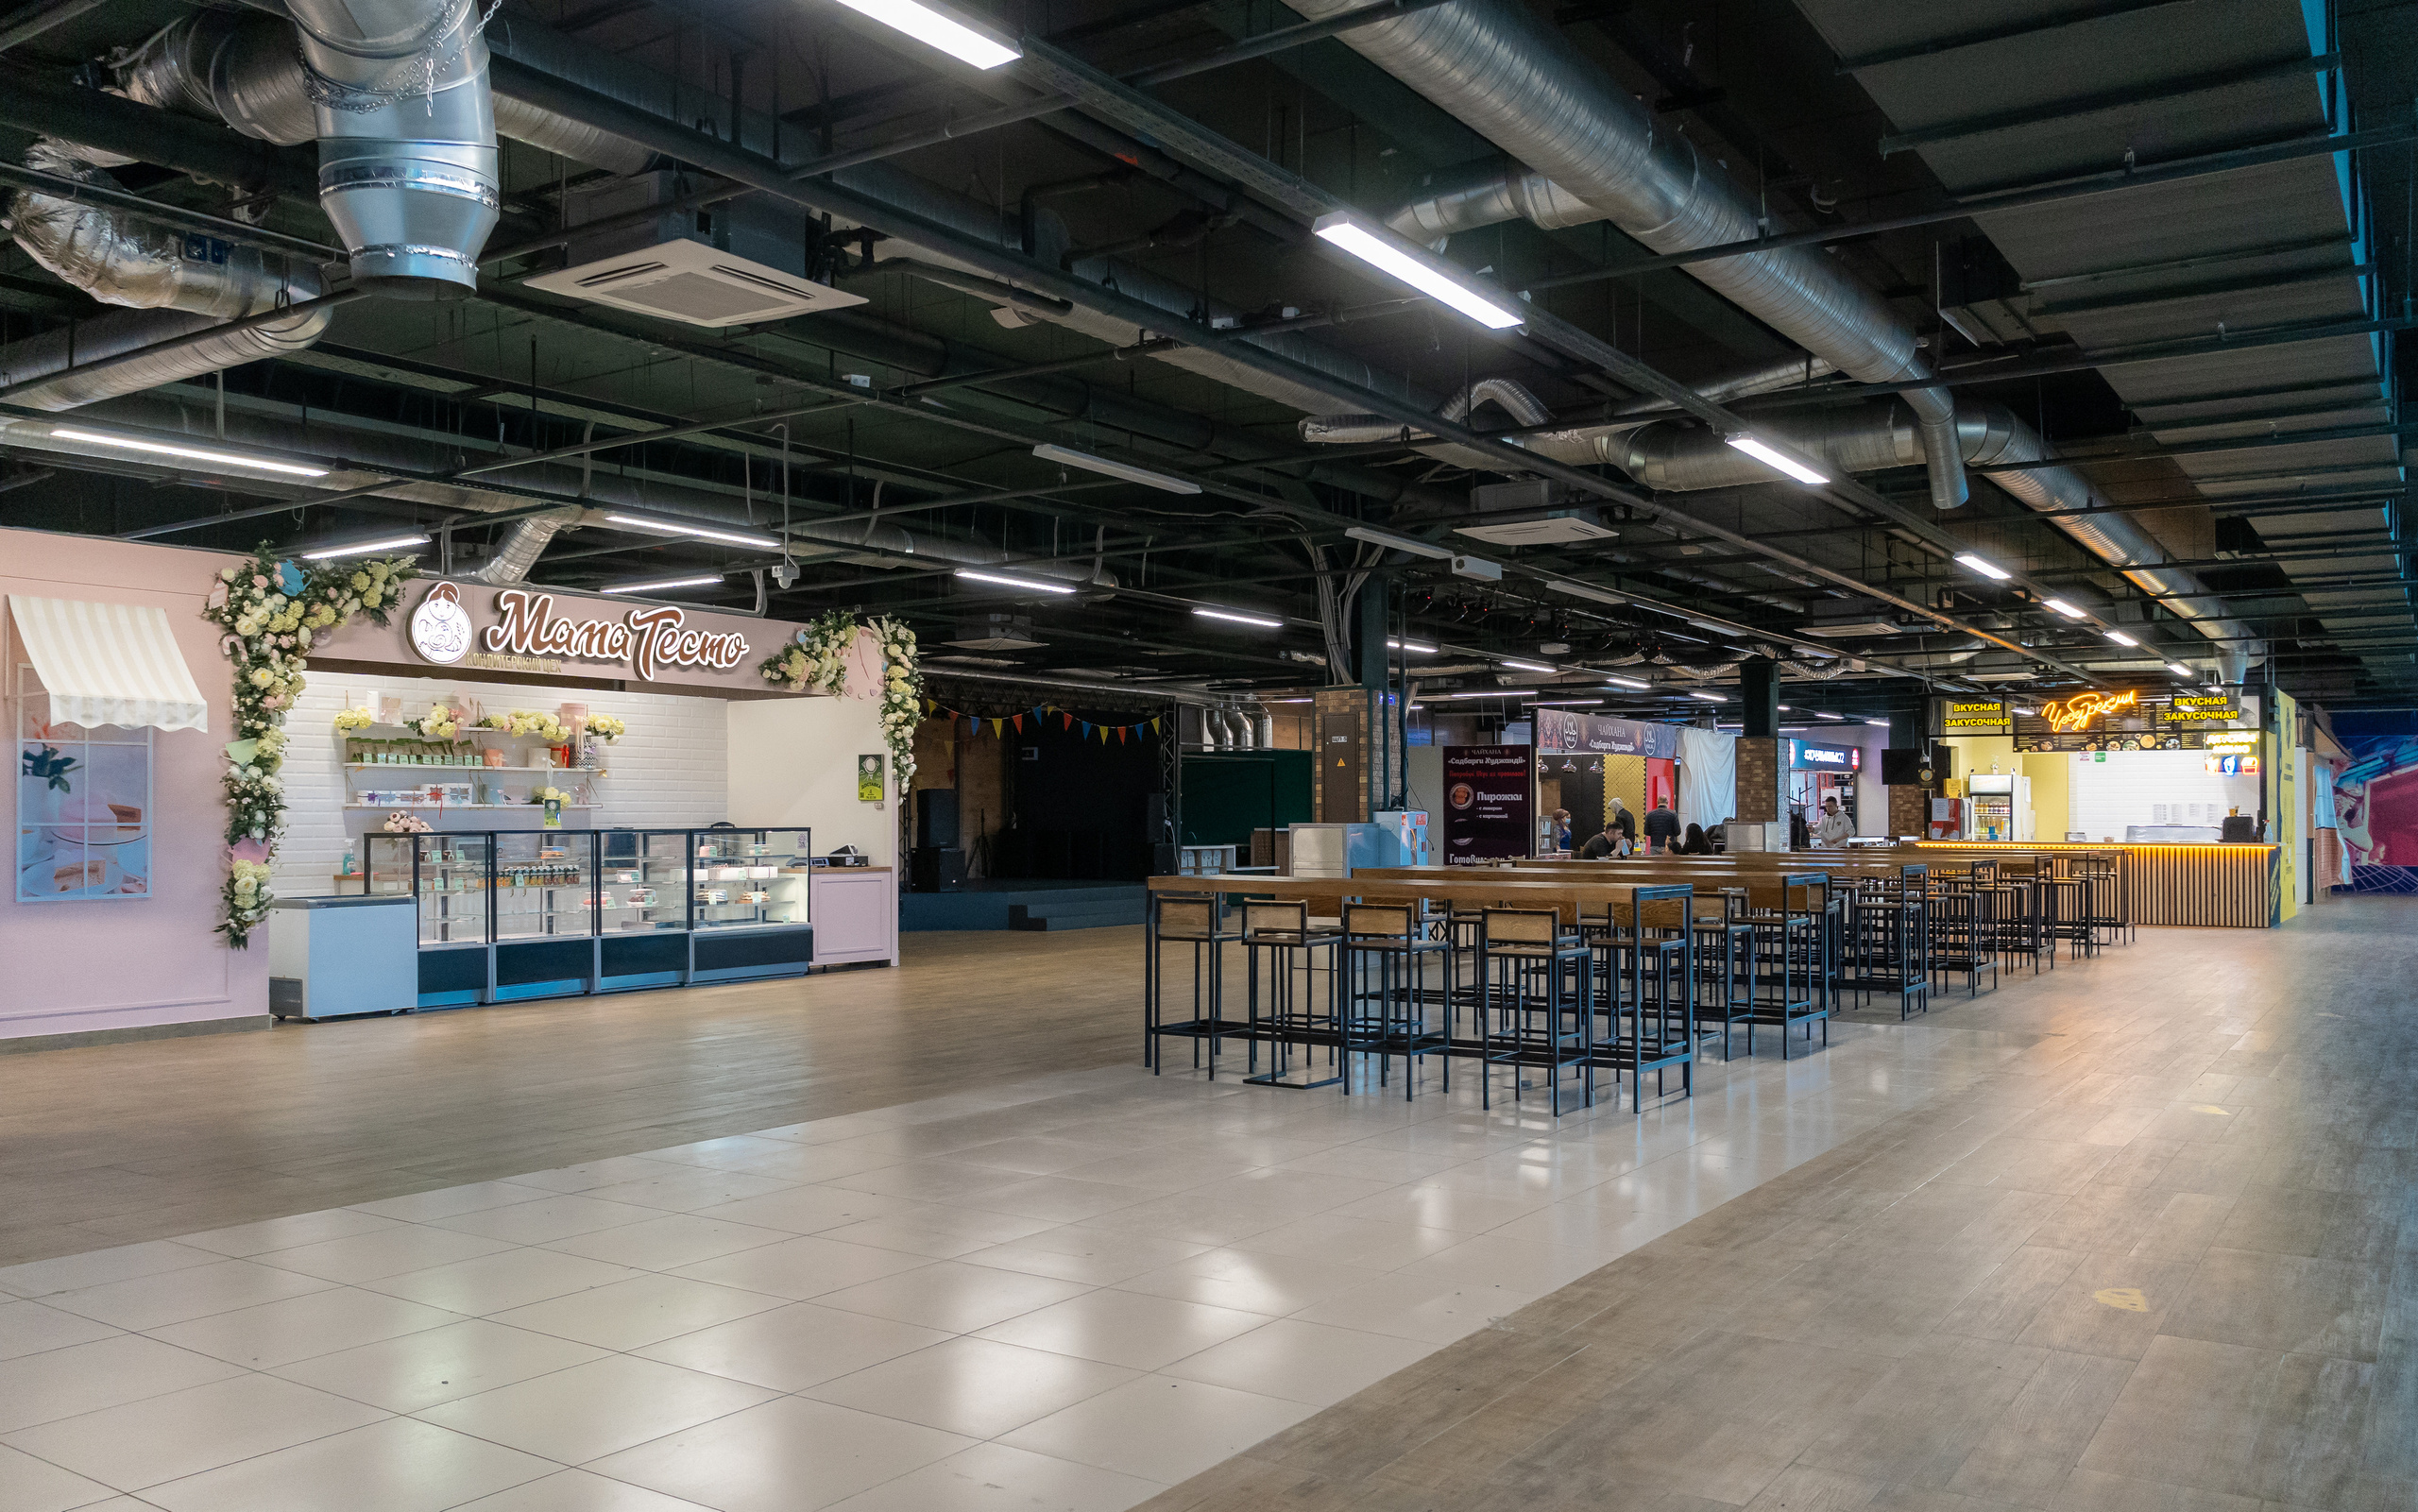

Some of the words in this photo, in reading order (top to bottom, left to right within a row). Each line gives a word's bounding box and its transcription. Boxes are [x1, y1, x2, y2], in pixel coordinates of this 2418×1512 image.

[466, 653, 541, 671] КОНДИТЕРСКИЙ
[543, 658, 562, 673] ЦЕХ
[2173, 696, 2227, 706] ВКУСНАЯ
[1953, 703, 2001, 712] ВКУСНАЯ
[2163, 710, 2239, 721] ЗАКУСОЧНАЯ
[1944, 717, 2011, 727] ЗАКУСОЧНАЯ
[1597, 723, 1626, 738] ЧАЙХАНА
[1476, 791, 1523, 804] Пирожки
